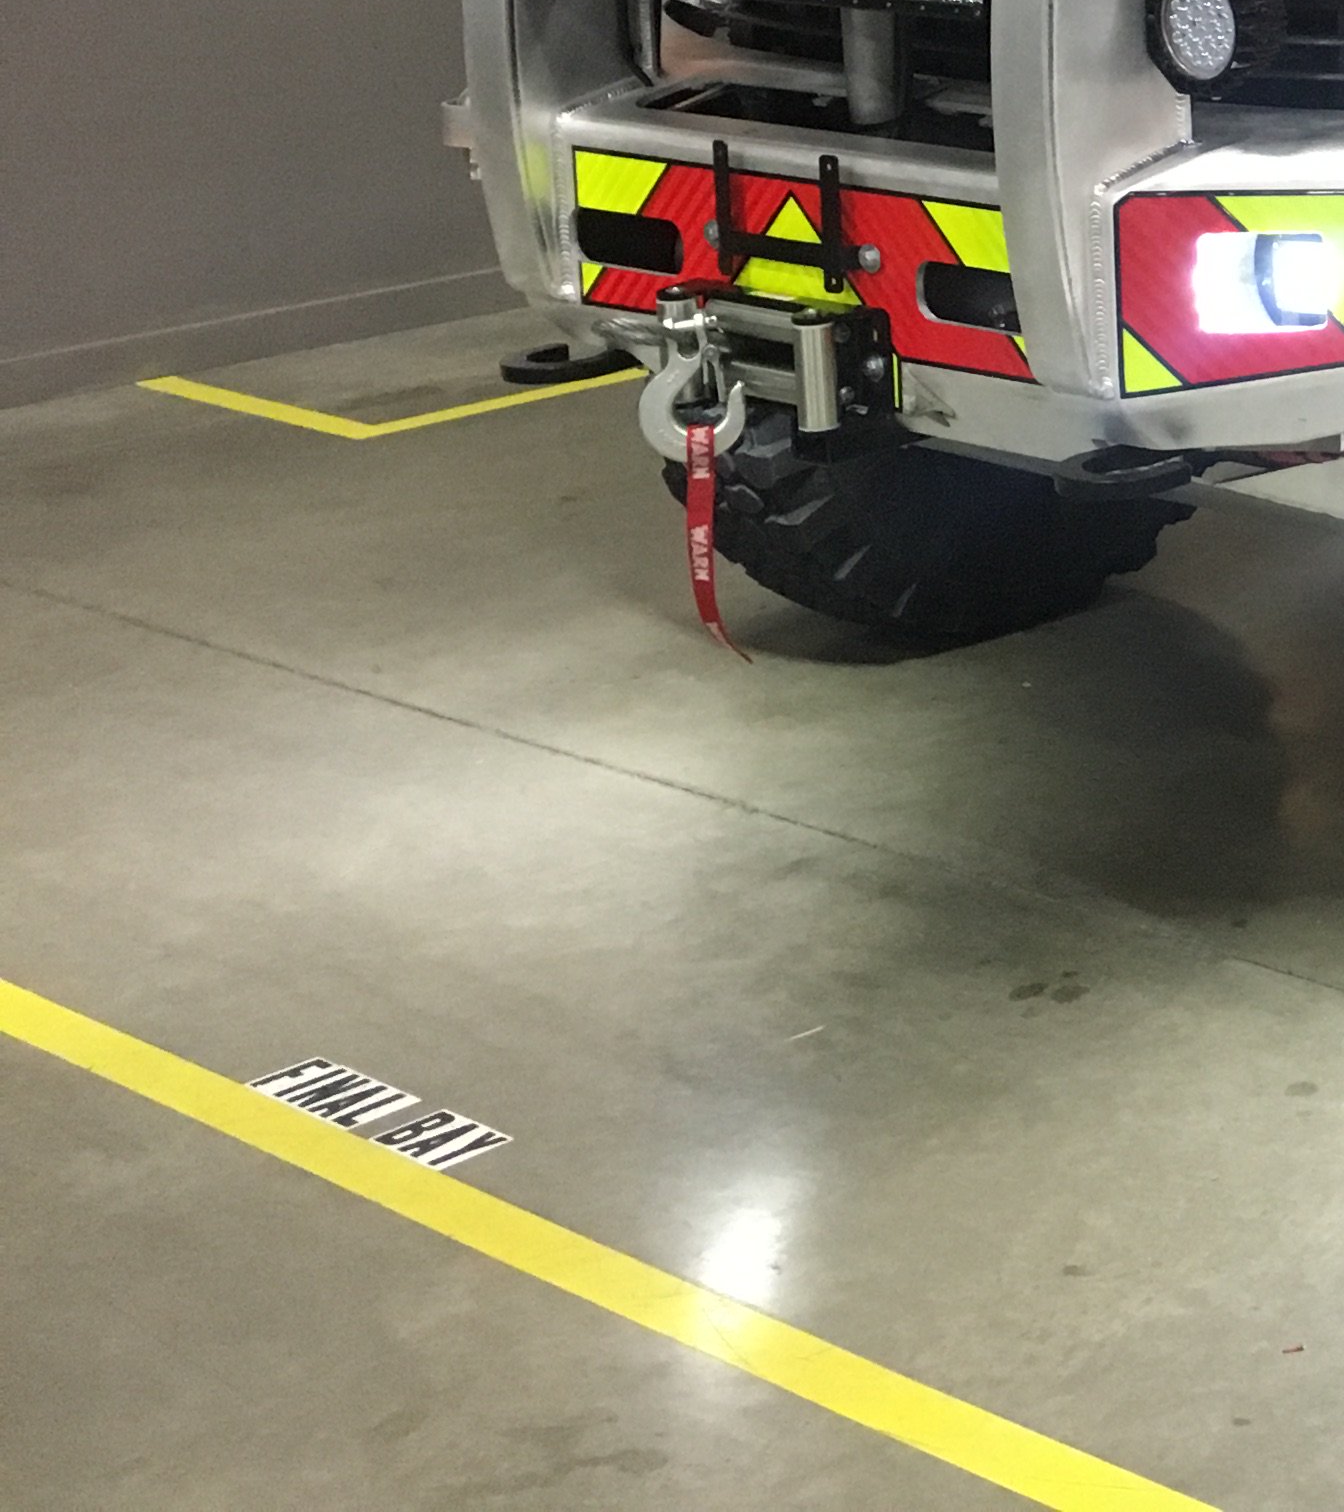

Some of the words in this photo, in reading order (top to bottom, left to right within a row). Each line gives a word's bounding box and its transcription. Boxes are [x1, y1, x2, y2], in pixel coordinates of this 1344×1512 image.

[690, 425, 710, 480] WARN
[690, 525, 711, 582] WARN
[249, 1058, 407, 1128] FINAL
[373, 1111, 508, 1166] BAY
